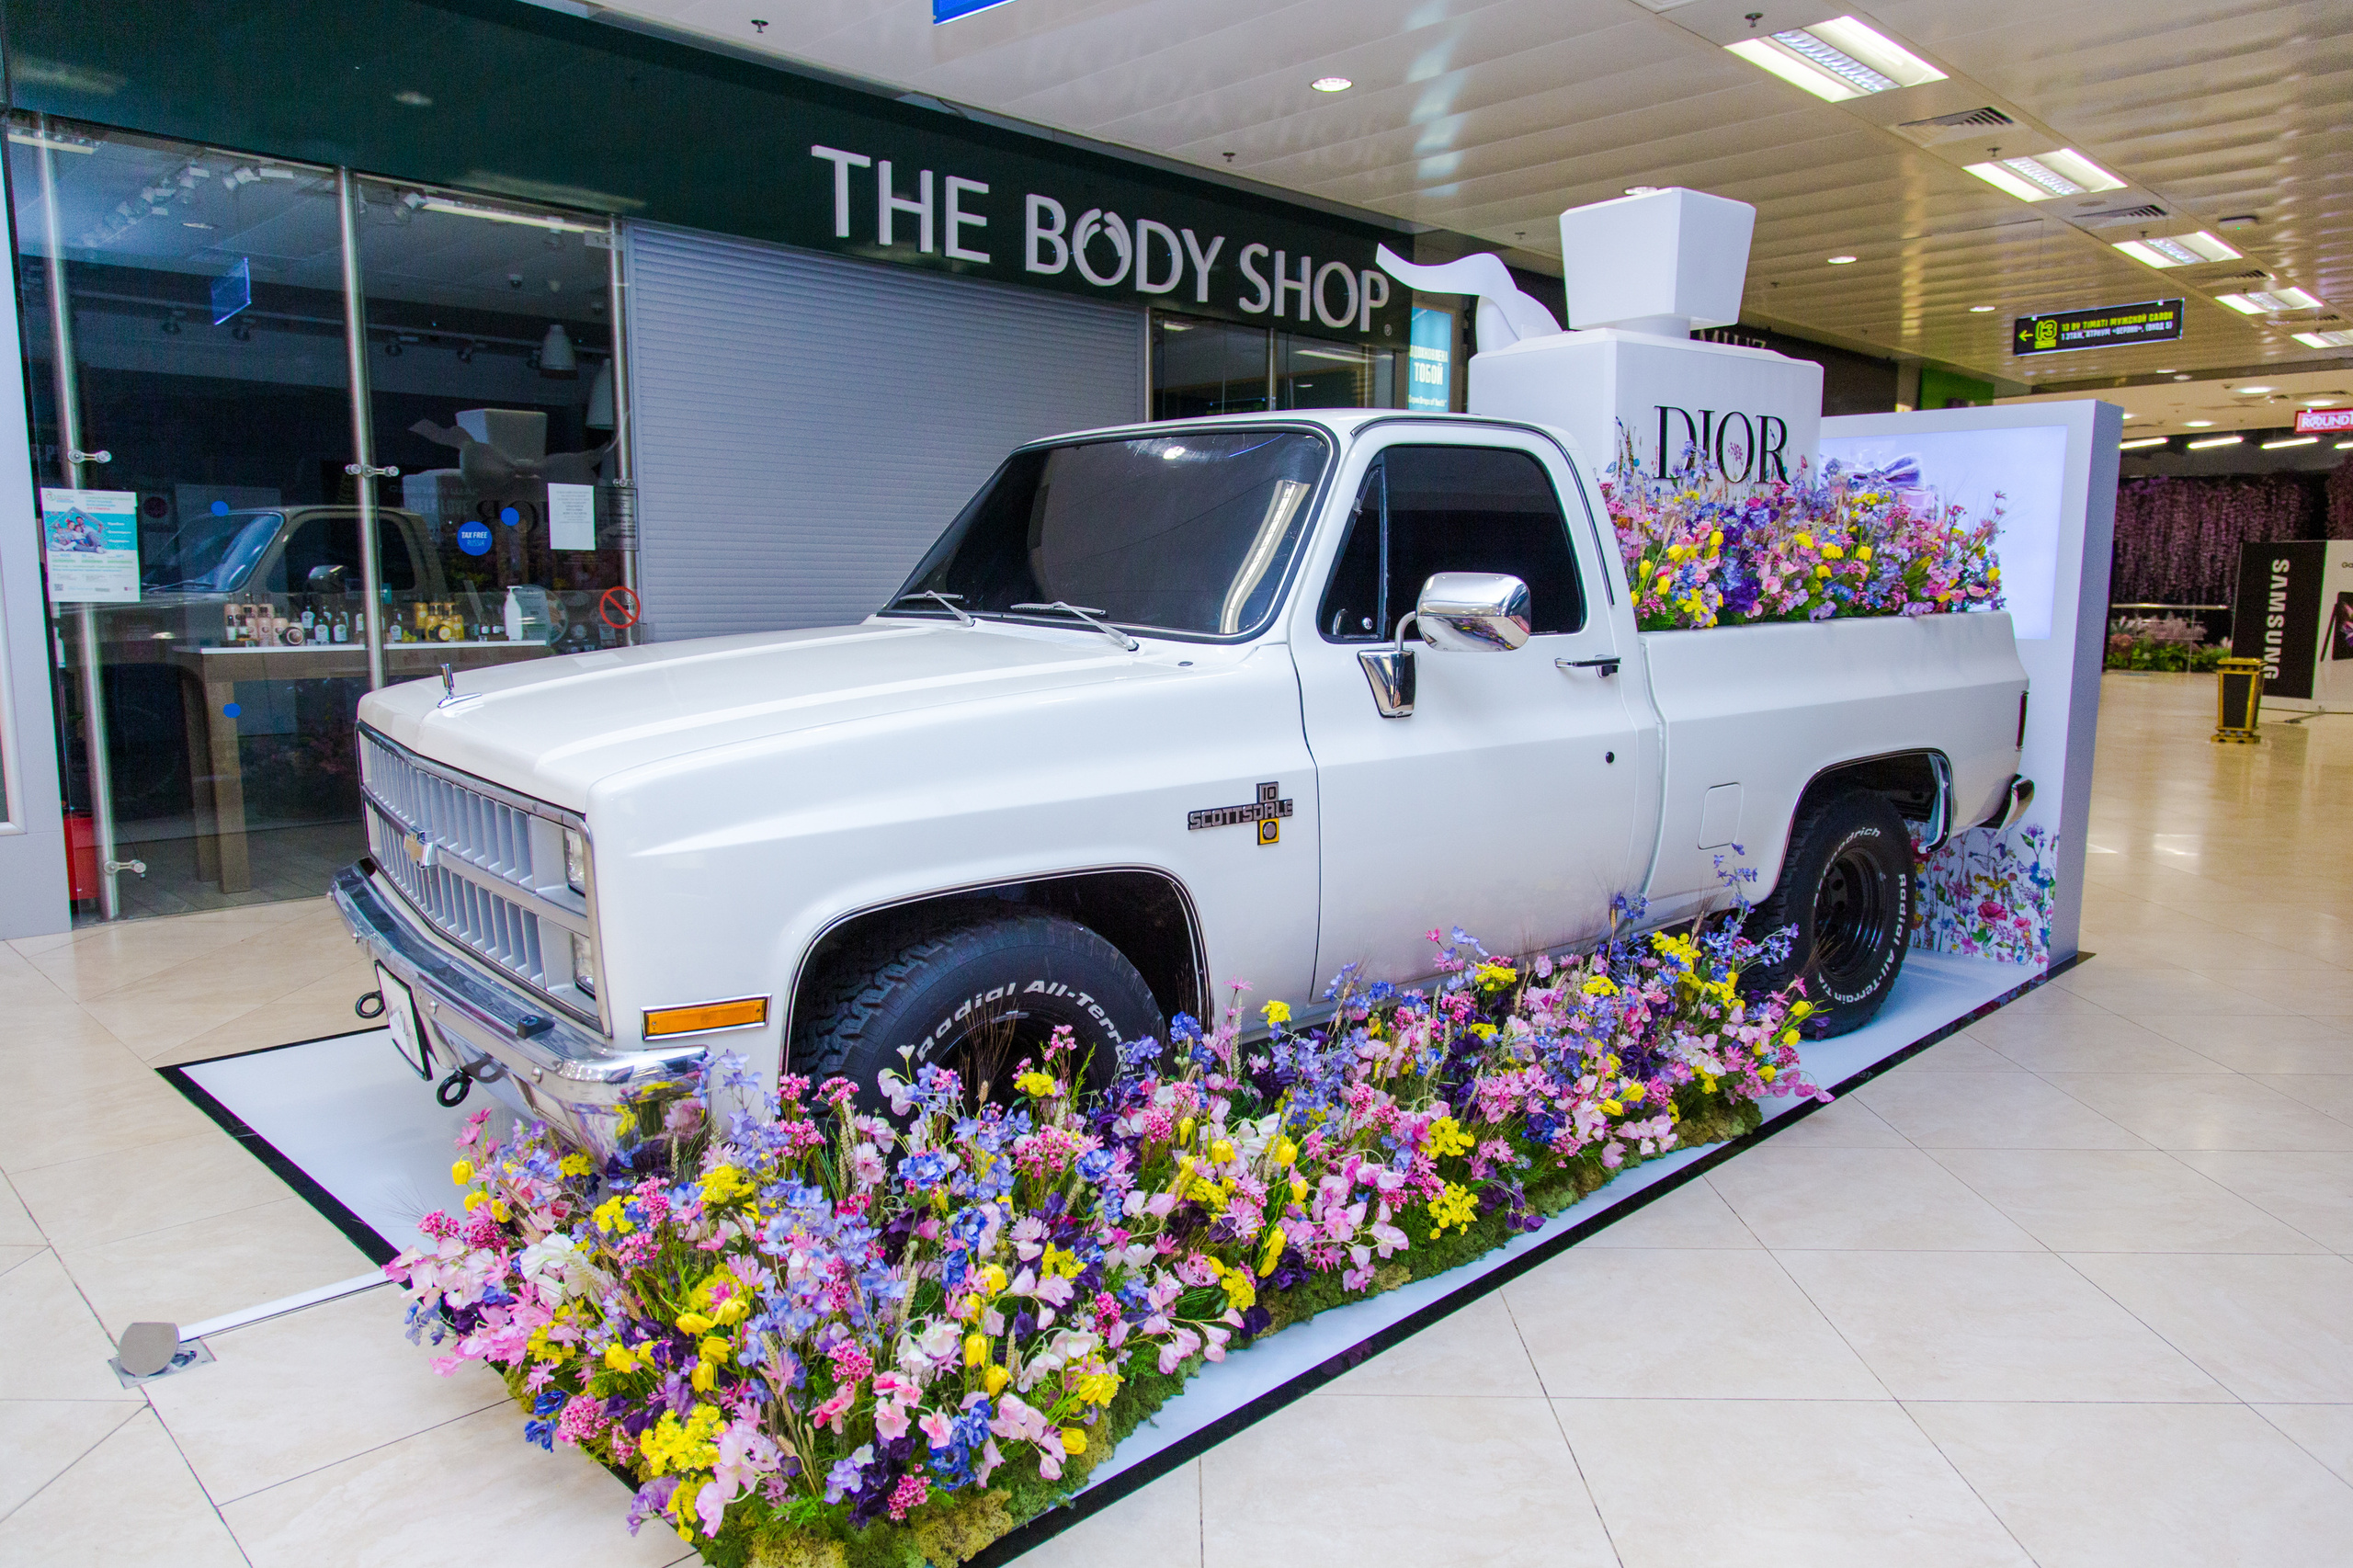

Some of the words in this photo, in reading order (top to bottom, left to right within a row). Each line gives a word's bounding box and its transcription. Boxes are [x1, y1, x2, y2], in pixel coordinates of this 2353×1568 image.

[811, 144, 991, 265] THE
[1026, 193, 1225, 303] BODY
[1238, 243, 1390, 333] SHOP
[2109, 313, 2147, 327] МУЖСКОЙ
[1414, 362, 1444, 386] ТОБОЙ
[1654, 405, 1791, 485] DIOR
[2263, 558, 2291, 680] SAMSUNG
[1188, 799, 1293, 830] SCOTTSDALE
[1893, 874, 1907, 946] Radial
[1834, 949, 1895, 1005] All-Terrain
[916, 983, 1017, 1062] Radial
